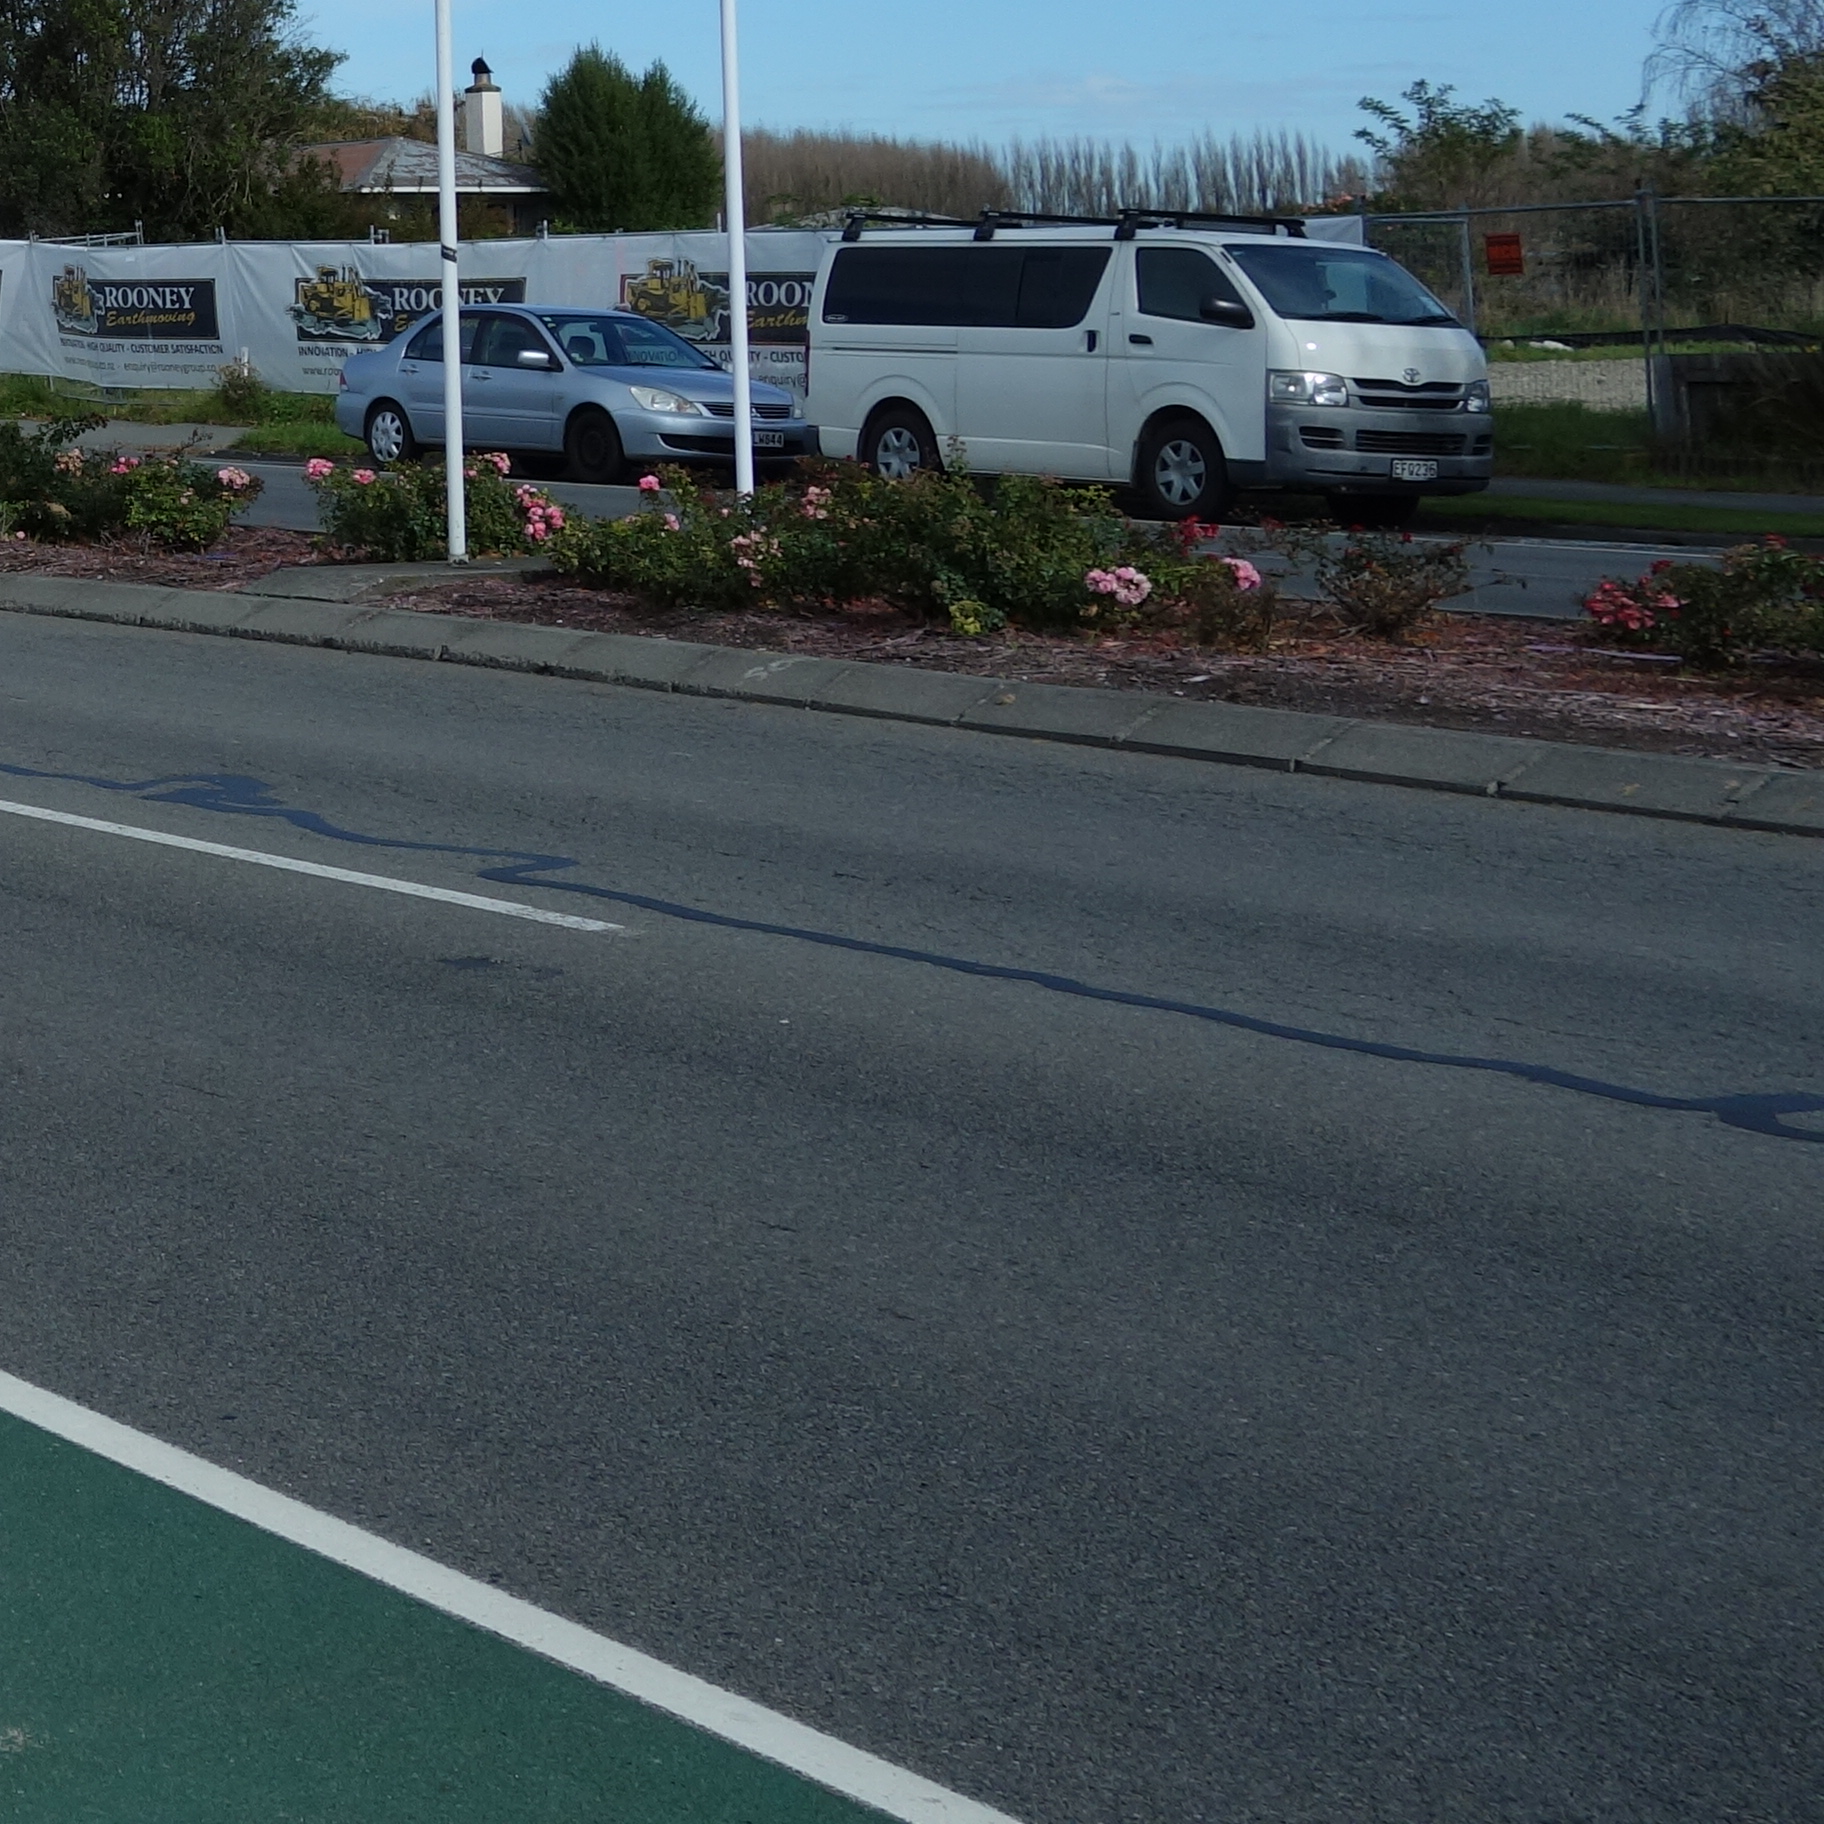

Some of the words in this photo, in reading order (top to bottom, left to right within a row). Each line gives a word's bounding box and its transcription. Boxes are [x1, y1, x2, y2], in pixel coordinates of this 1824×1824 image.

[103, 285, 195, 309] ROONEY
[105, 309, 197, 327] Earthmoving
[99, 342, 125, 353] QUALITY
[130, 343, 171, 354] CUSTOMER
[171, 343, 224, 355] SATISFACTION
[769, 351, 805, 363] CUSTO
[1393, 461, 1437, 477] EFQ236
